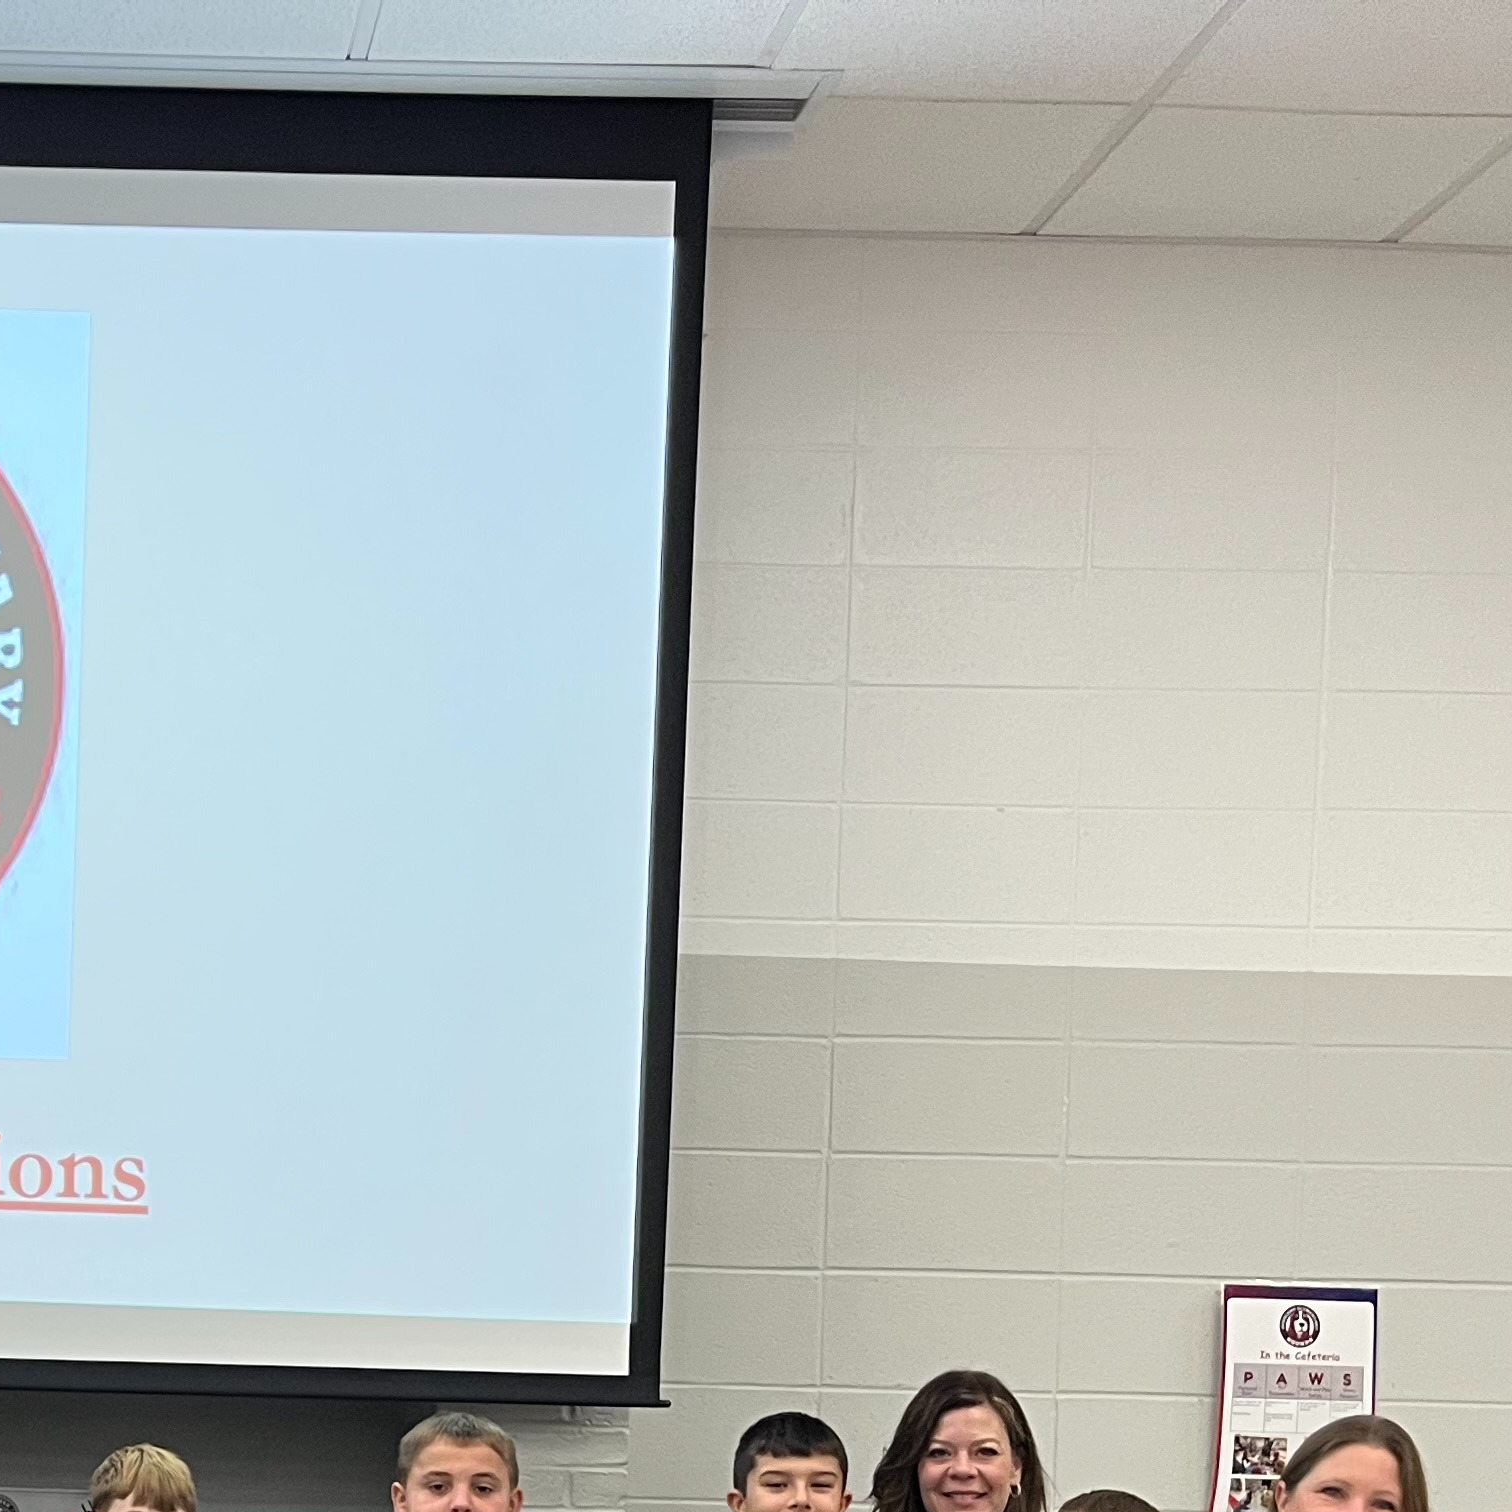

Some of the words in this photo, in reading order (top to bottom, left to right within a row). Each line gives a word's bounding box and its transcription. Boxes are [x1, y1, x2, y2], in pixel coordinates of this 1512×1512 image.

[1275, 1351, 1290, 1361] the
[1294, 1351, 1341, 1362] Cafeteria
[1243, 1372, 1254, 1384] P
[1276, 1373, 1288, 1385] A
[1308, 1372, 1325, 1386] W
[1342, 1373, 1352, 1387] S
